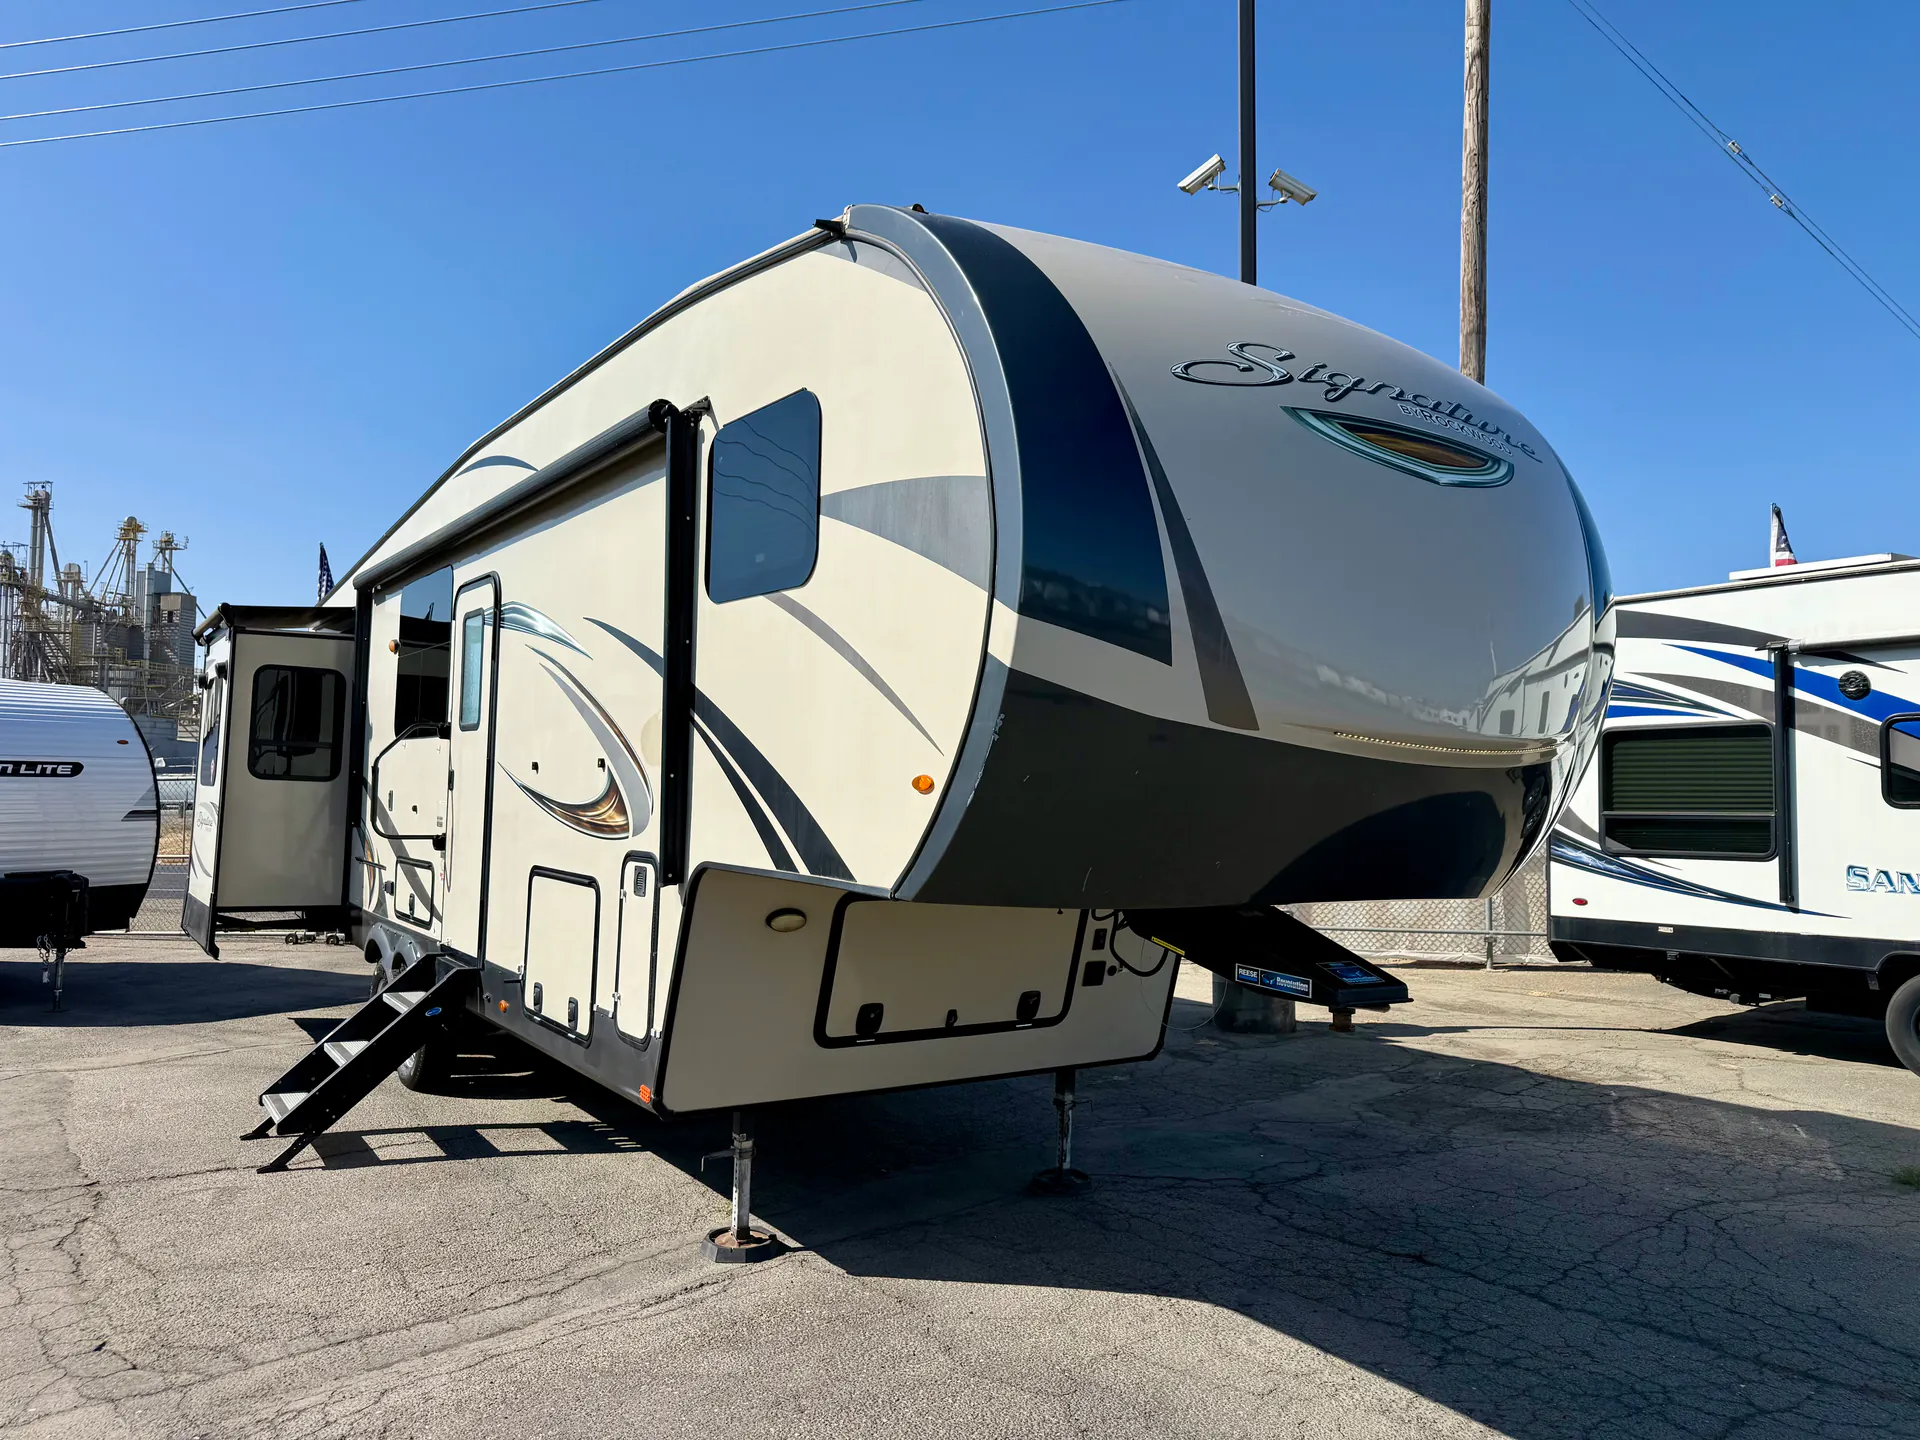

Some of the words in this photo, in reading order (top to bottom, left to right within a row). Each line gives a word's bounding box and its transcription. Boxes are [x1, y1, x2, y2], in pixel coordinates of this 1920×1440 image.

[1170, 341, 1543, 463] Signature
[20, 764, 73, 774] LITE
[1238, 968, 1258, 978] REESE
